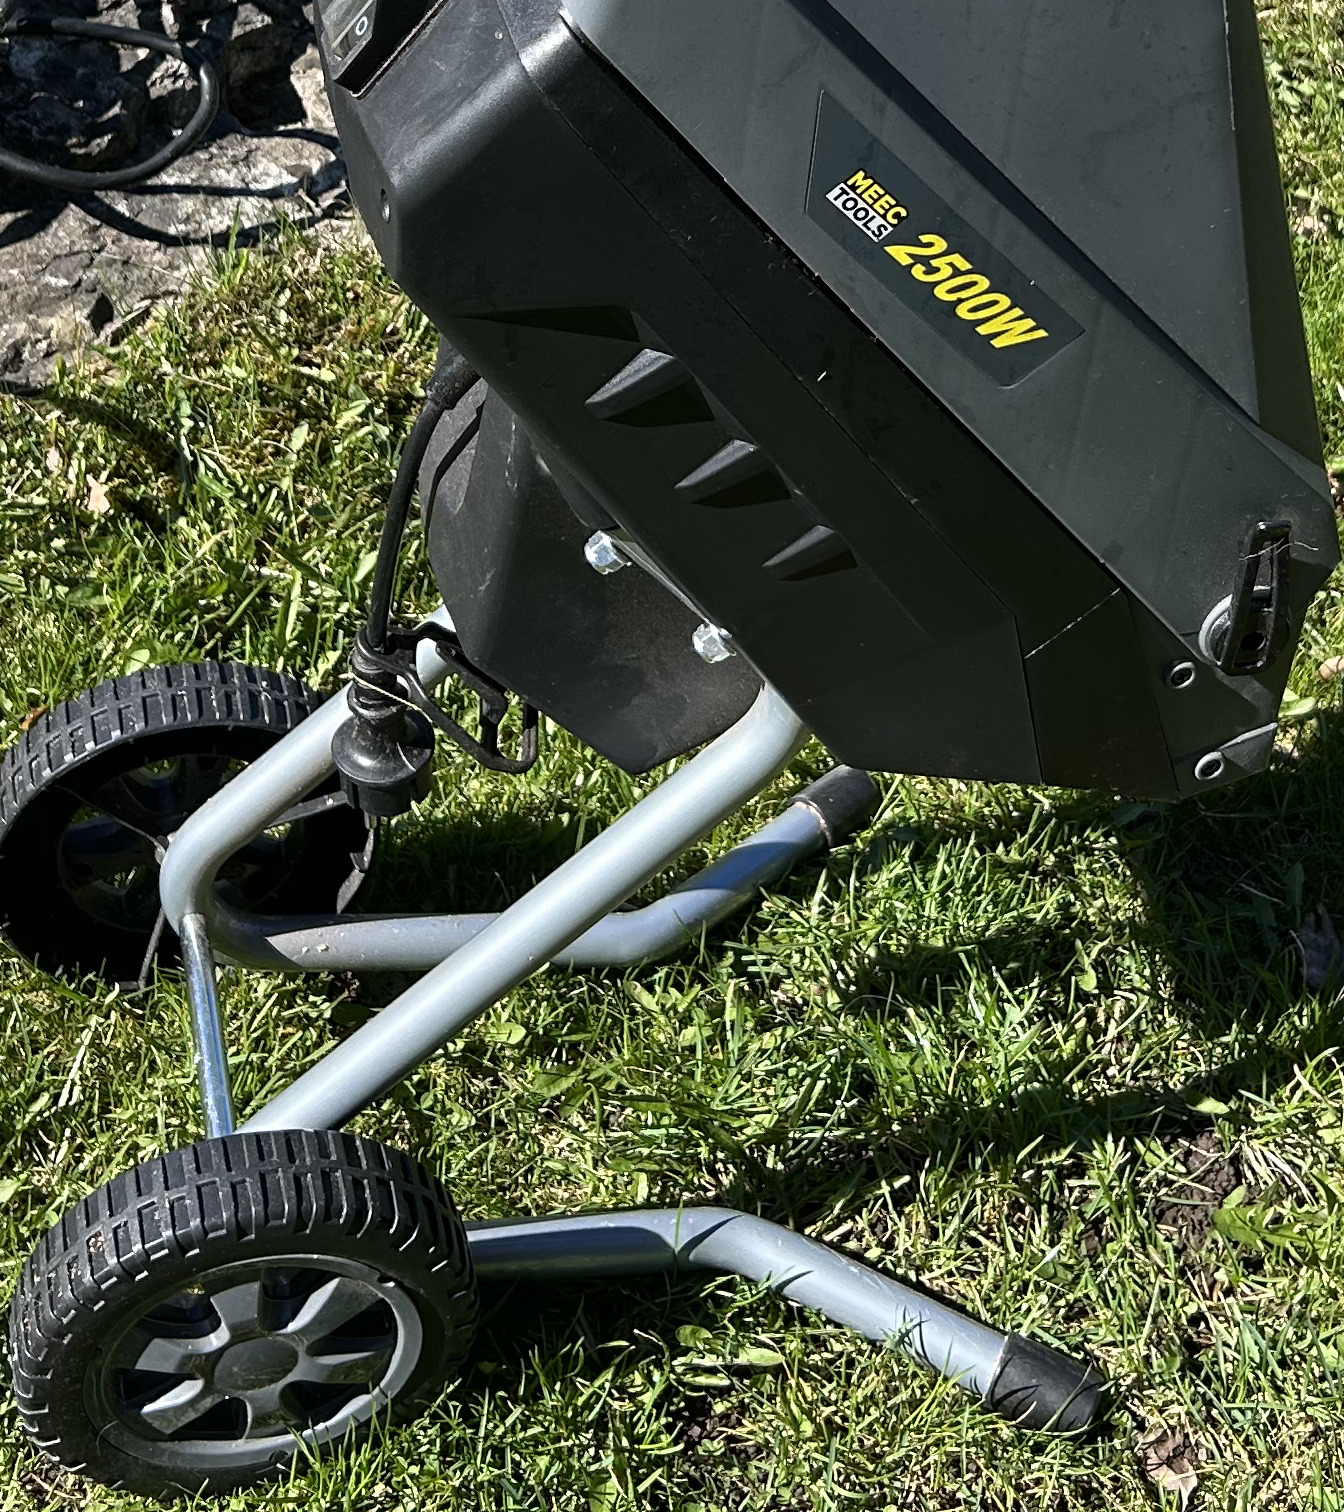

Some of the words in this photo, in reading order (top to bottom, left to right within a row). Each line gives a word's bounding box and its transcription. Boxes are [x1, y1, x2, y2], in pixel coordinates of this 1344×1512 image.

[830, 186, 889, 240] TOOLS
[846, 171, 907, 225] MEEC
[884, 233, 1049, 349] 2500W
